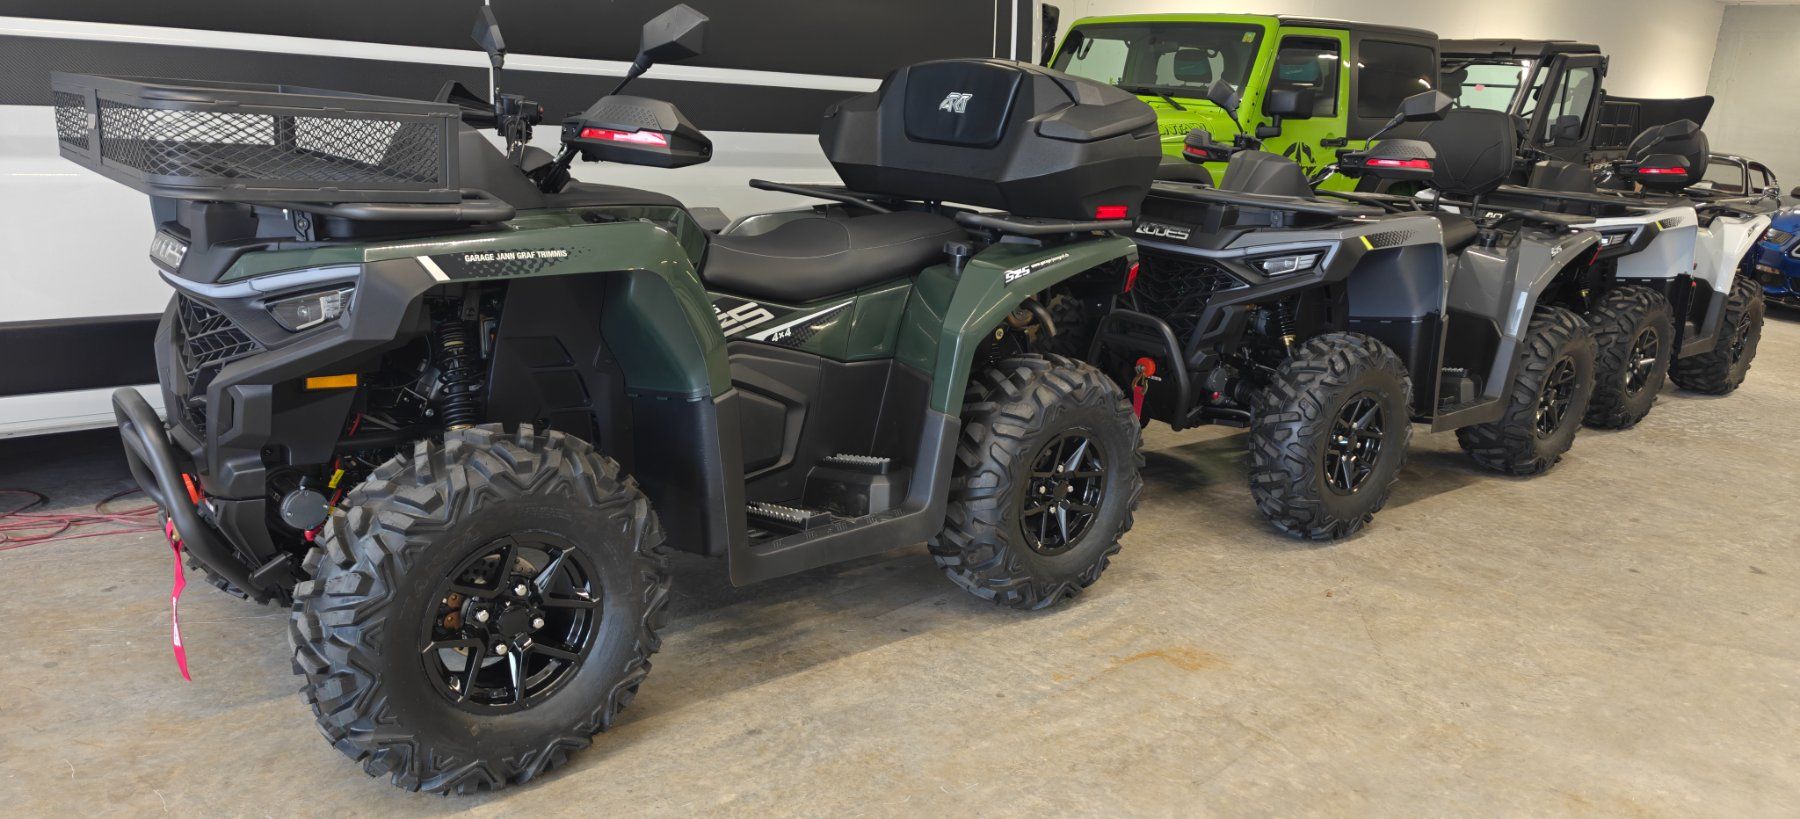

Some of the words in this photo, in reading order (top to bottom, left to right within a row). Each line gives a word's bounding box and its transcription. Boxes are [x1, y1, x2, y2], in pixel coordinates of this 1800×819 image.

[464, 253, 495, 262] GARAGE
[495, 251, 516, 261] JANN
[516, 250, 536, 260] GRAF
[536, 249, 568, 259] TRIMMIS
